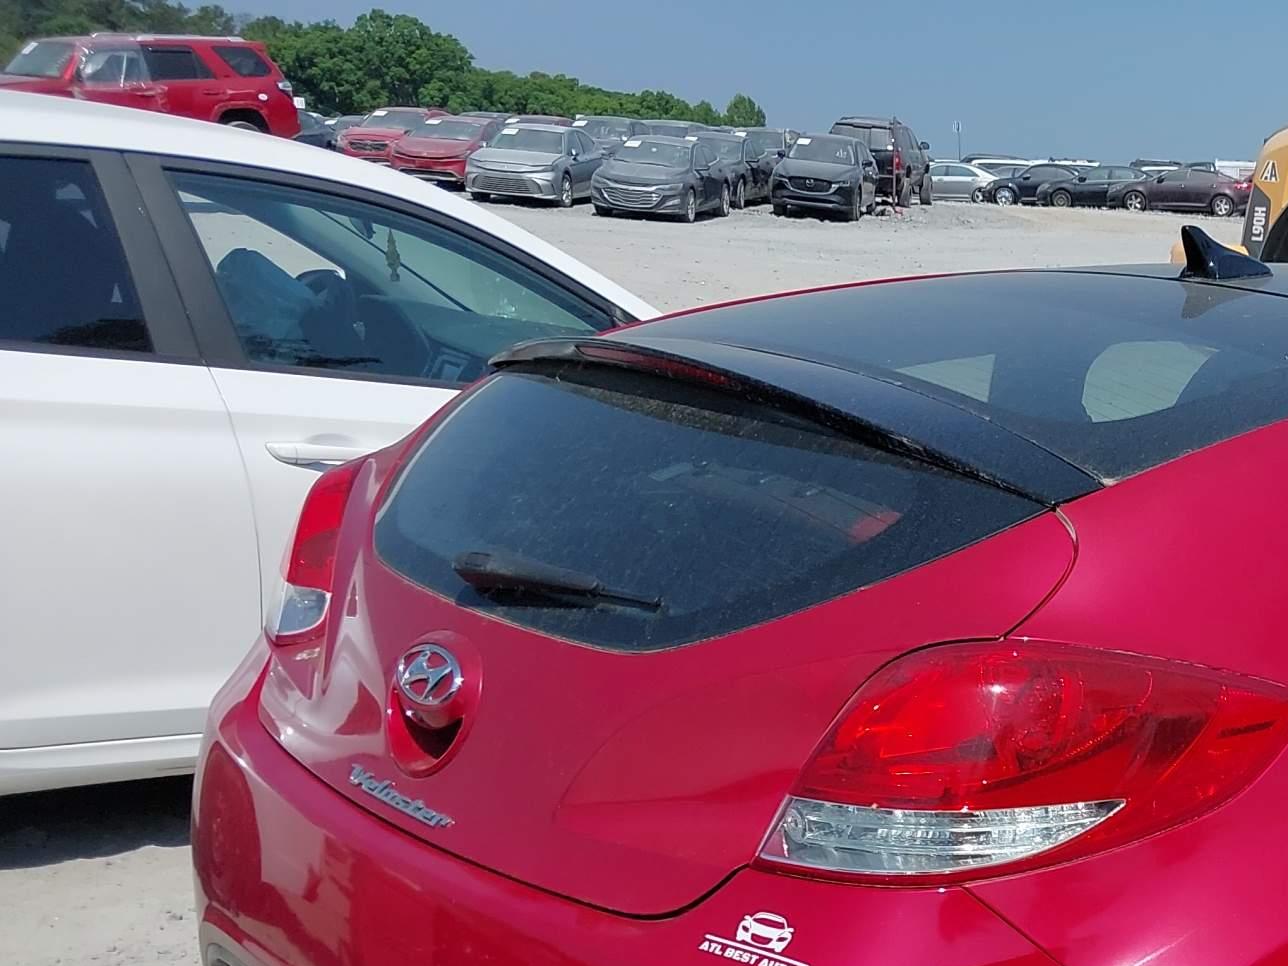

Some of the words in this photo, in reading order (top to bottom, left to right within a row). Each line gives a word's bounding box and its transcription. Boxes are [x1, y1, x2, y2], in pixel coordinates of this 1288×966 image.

[1251, 206, 1267, 242] L90H
[349, 763, 456, 827] Veloster
[698, 941, 723, 955] ATL
[723, 947, 759, 965] BEST
